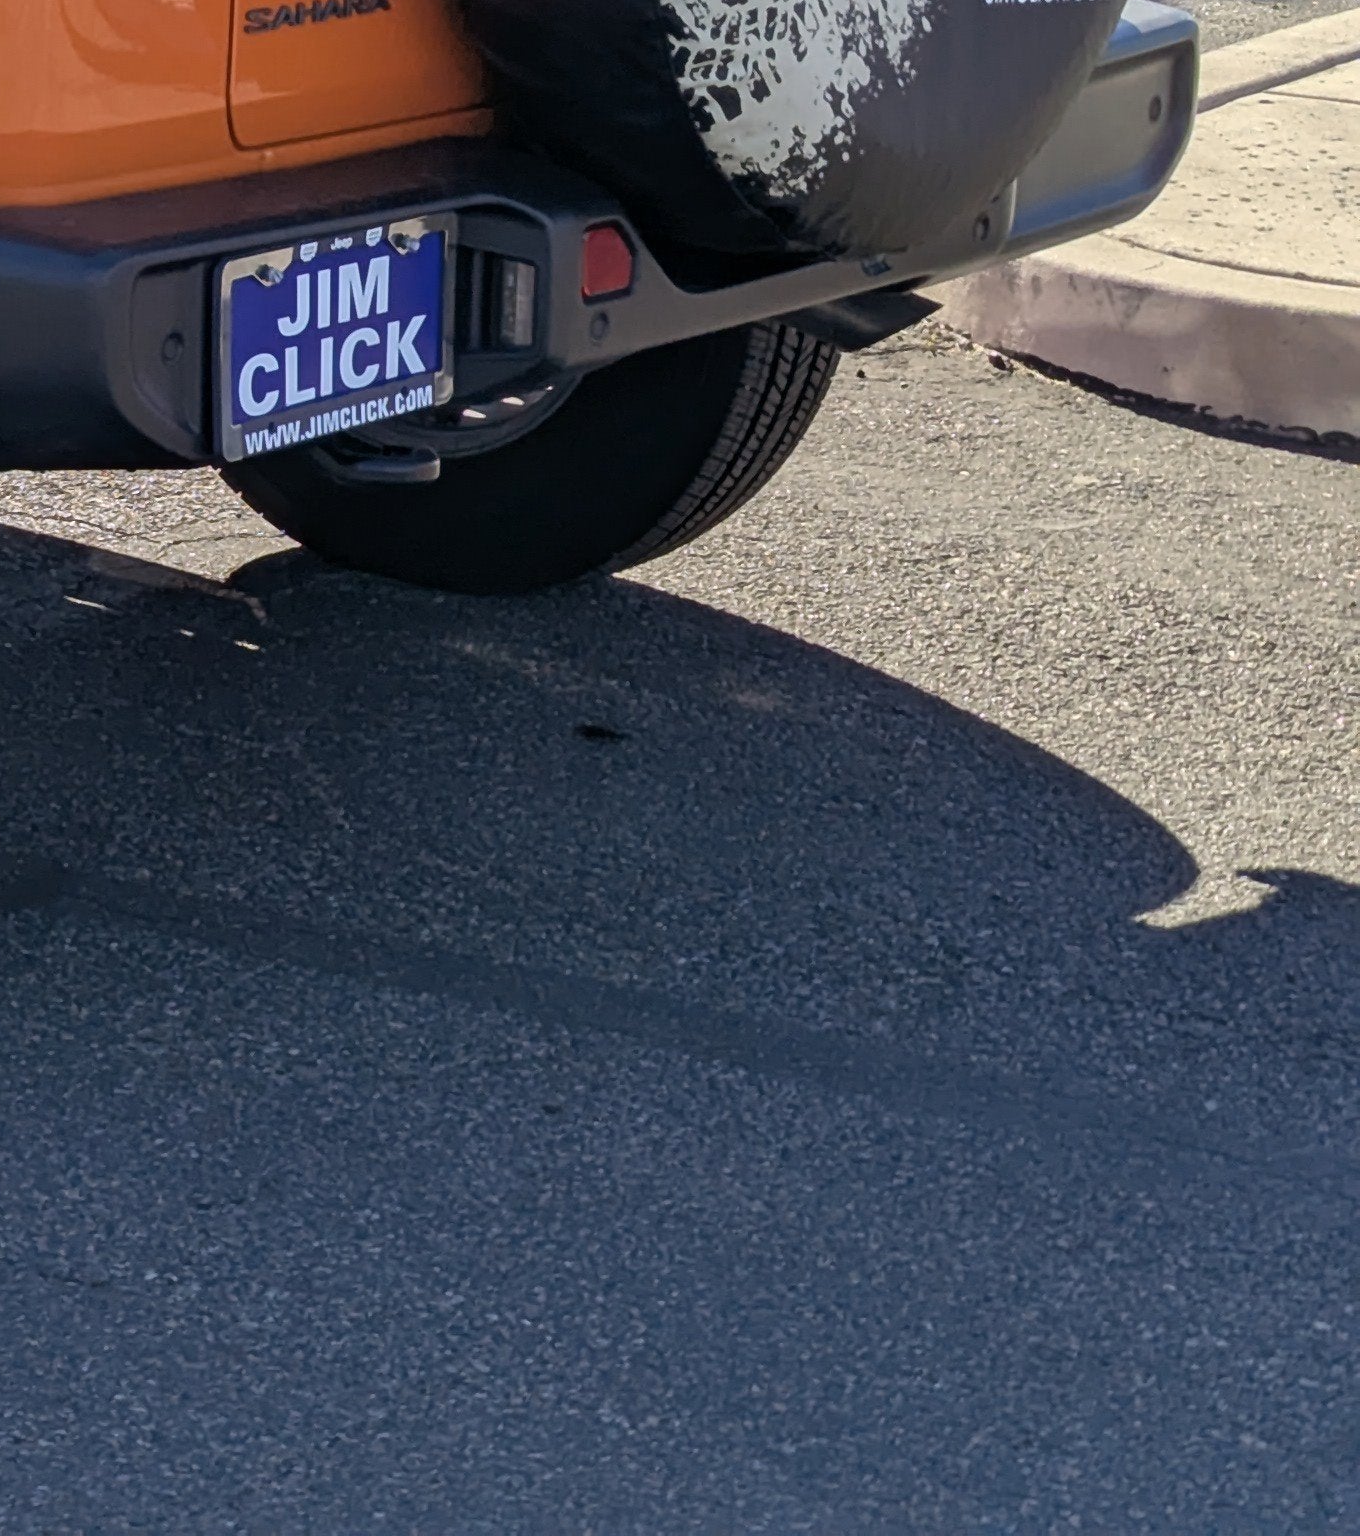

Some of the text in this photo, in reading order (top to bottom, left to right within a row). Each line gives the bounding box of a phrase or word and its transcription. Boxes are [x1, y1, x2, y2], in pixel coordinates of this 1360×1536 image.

[277, 255, 391, 338] JIM
[238, 314, 428, 417] CLICK
[245, 385, 434, 455] WWW.JIMCLICK.COM
